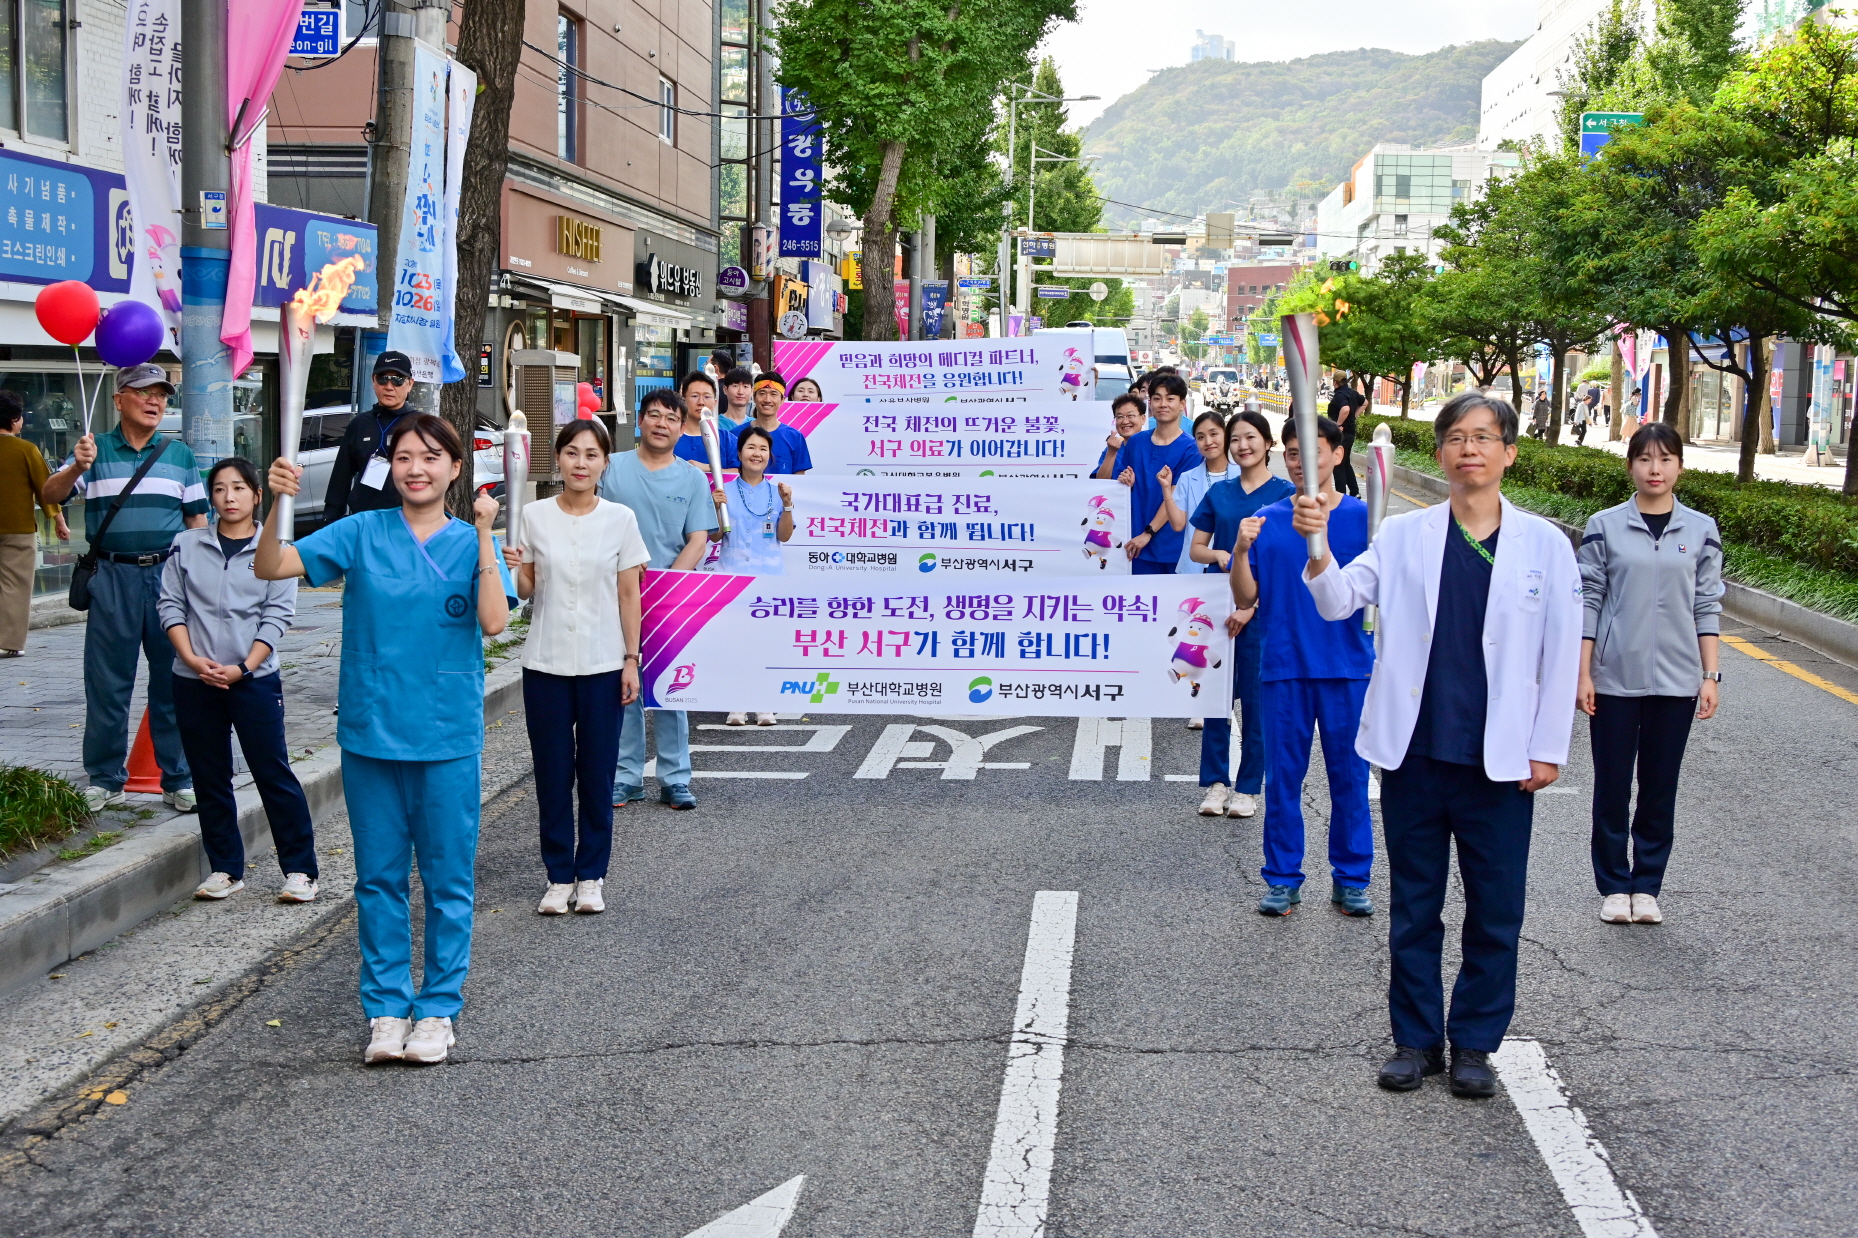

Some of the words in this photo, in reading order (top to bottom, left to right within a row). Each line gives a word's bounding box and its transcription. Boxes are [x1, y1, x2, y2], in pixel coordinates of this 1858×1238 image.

[300, 14, 334, 36] 번길
[783, 239, 819, 252] 246-5515
[660, 260, 680, 294] 위드유
[683, 267, 702, 298] 부동산
[396, 290, 434, 312] 10.26
[839, 353, 884, 369] 믿음과
[888, 352, 933, 369] 희망의
[938, 350, 984, 368] 메디컬
[988, 348, 1039, 366] 파트너,
[862, 372, 937, 390] 전국체전을
[942, 370, 1023, 389] 응원합니다!
[1524, 377, 1533, 390] 2
[862, 415, 898, 433] 전국
[903, 415, 957, 433] 체전의
[963, 416, 1018, 434] 뜨거운
[1023, 415, 1065, 435] 불꽃,
[867, 439, 904, 458] 서구
[909, 439, 964, 458] 의료가
[969, 439, 1065, 459] 이어갑니다!
[840, 491, 945, 515] 국가대표급
[951, 493, 999, 517] 진료,
[806, 516, 911, 540] 전국체전과
[916, 520, 958, 541] 함께
[965, 522, 1035, 542] 뜁니다!
[808, 564, 833, 572] Dong-A
[835, 564, 868, 573] University
[748, 595, 820, 620] 승리를
[826, 596, 877, 620] 향한
[881, 595, 935, 623] 도전,
[942, 594, 1016, 622] 생명을
[1022, 594, 1095, 623] 지키는
[1101, 594, 1158, 623] 약속!
[792, 629, 849, 658] 부산
[856, 629, 942, 658] 서구가
[951, 629, 1006, 659] 함께
[1017, 630, 1110, 660] 합니다!
[846, 681, 942, 697] 부산대학교병원
[889, 698, 917, 706] University
